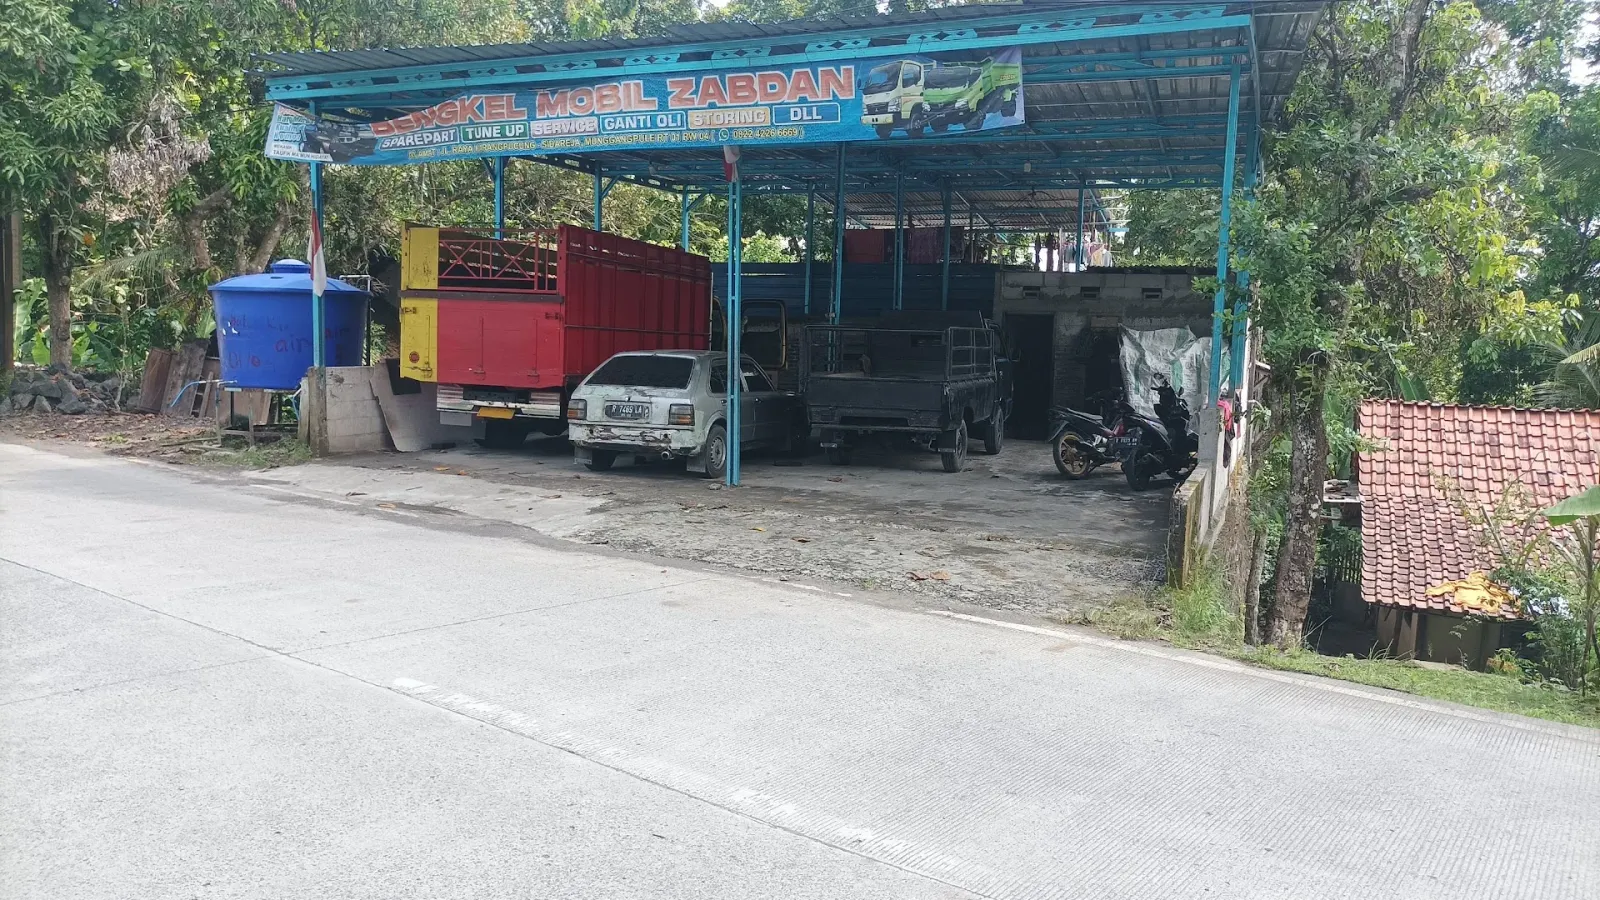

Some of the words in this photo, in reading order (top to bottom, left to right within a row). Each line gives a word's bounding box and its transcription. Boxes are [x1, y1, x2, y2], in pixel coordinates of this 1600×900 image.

[536, 80, 658, 118] MOBIL
[667, 65, 855, 109] ZABDAN
[604, 116, 651, 130] GANTI
[656, 112, 681, 127] OLI
[693, 110, 765, 126] STORING
[789, 107, 821, 121] DLL
[465, 126, 500, 140] TUNE
[505, 124, 524, 137] UP
[534, 120, 595, 135] SERVICE
[381, 129, 455, 148] SPAREPART
[453, 144, 474, 153] RAYA
[656, 131, 668, 143] RT
[682, 129, 697, 141] RW
[699, 128, 709, 140] 04
[733, 127, 753, 139] 0822
[756, 126, 776, 138] 4226
[778, 125, 797, 137] 6669
[611, 405, 616, 413] R
[634, 405, 642, 414] LA
